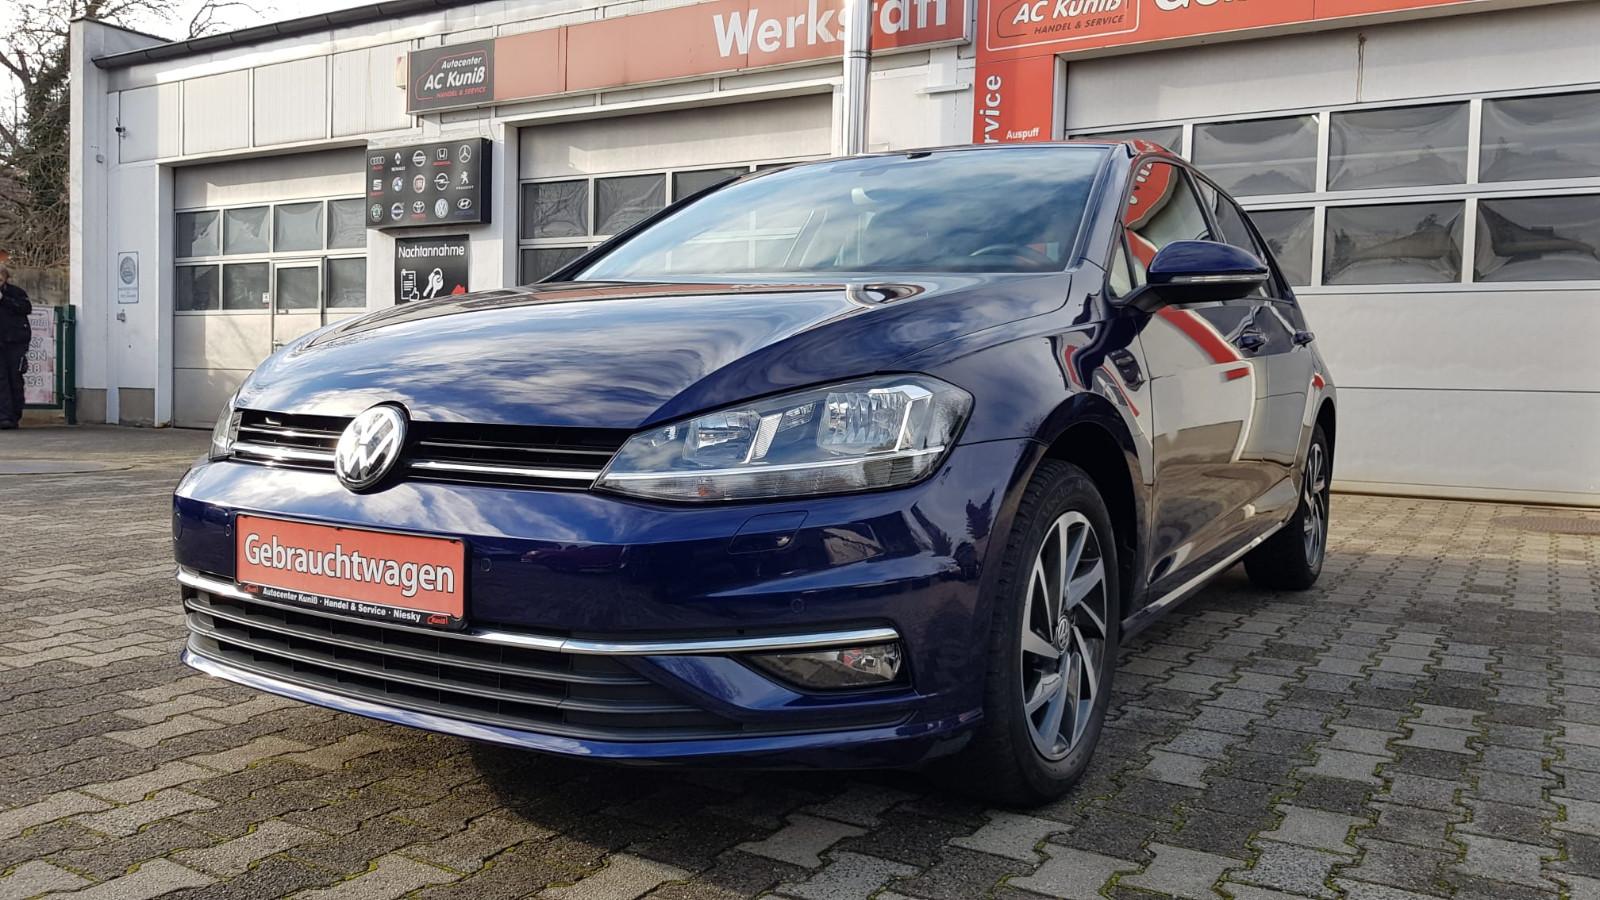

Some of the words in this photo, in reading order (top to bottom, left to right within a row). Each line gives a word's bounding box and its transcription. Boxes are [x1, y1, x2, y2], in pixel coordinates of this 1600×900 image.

[1012, 1, 1047, 25] AC
[1034, 24, 1073, 36] HANDEL
[1074, 20, 1082, 29] &
[1084, 14, 1124, 27] SERVICE
[713, 0, 949, 57] Werkatt
[441, 56, 483, 69] Autocenter
[424, 72, 445, 91] AC
[446, 66, 486, 87] Kuniß
[1006, 127, 1039, 141] Auspuff
[398, 243, 465, 258] Nachtannahme
[244, 533, 455, 597] Gebrauchtwagen
[262, 587, 298, 601] Autocenter
[323, 598, 349, 610] Handel
[350, 602, 357, 611] &
[358, 602, 386, 616] Service
[393, 608, 421, 622] Niesky
